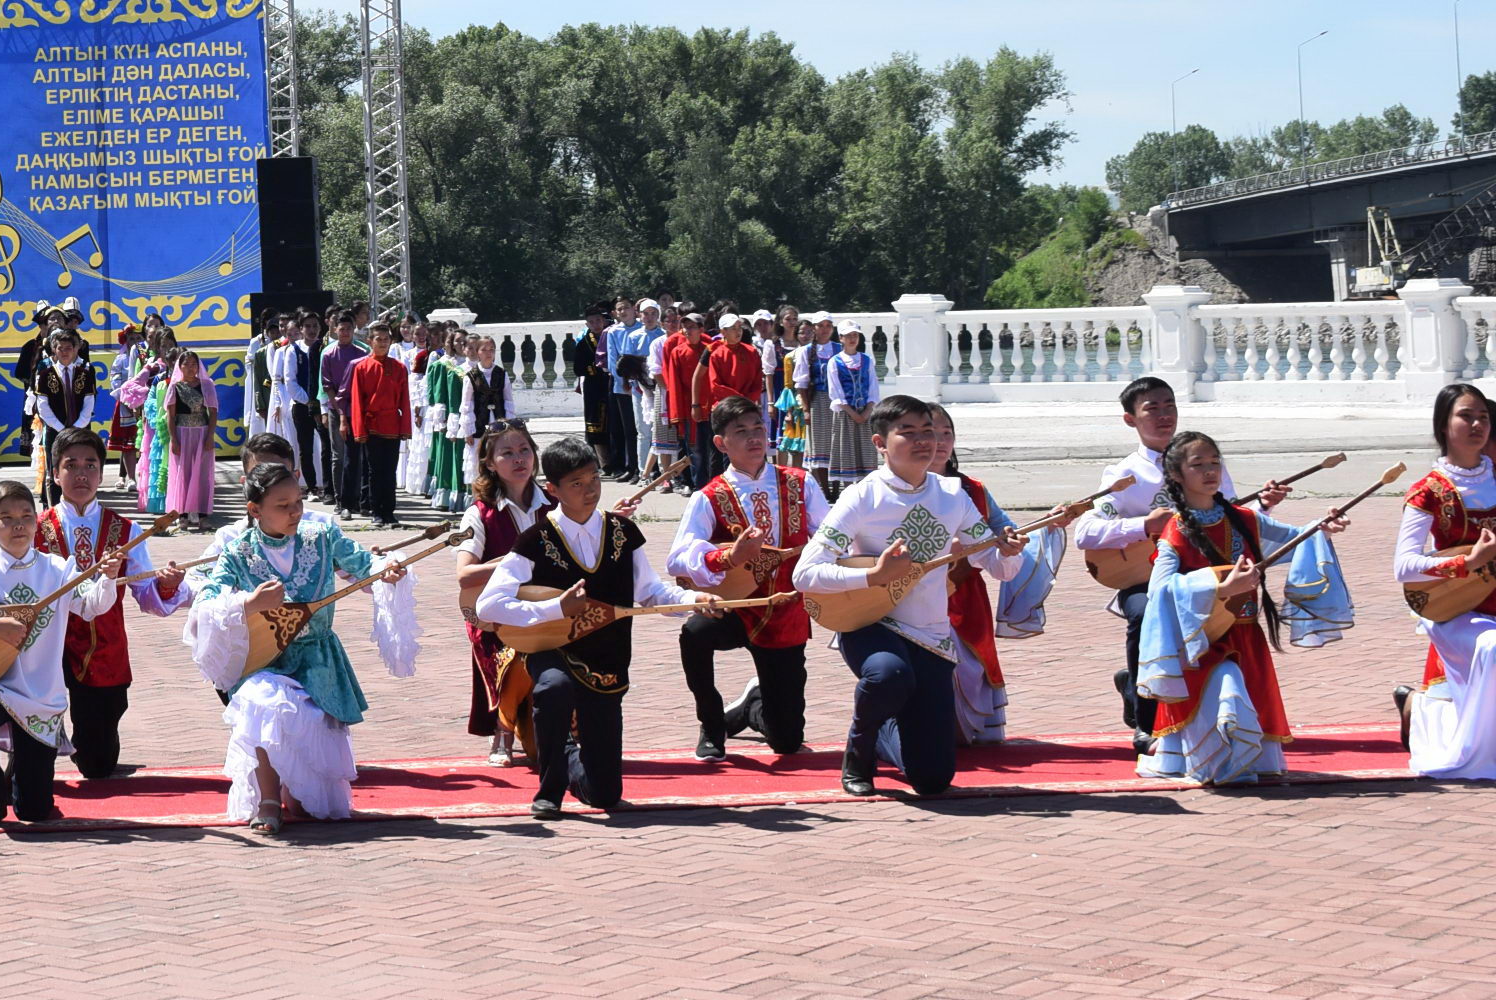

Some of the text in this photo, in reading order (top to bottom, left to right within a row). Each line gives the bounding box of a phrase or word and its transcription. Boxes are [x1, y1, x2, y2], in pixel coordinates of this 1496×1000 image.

[35, 42, 247, 62] АЛТЫН КҮН АСПАНЫ,
[33, 62, 251, 83] АЛТЫН ДӘН ДАЛАСЫ,
[46, 85, 239, 105] ЕРЛІКТІҢ ДАСТАНЫ,
[63, 106, 224, 126] ЕЛІМЕ ҚАРАШЫ!
[41, 126, 247, 148] ЕЖЕЛДЕН ЕР ДЕГЕН,
[16, 142, 266, 171] ДАҢҚЫМЫЗ ШЫҚТЫ ҒОЙ
[31, 173, 143, 190] НАМЫСЫН
[30, 186, 257, 213] ҚАЗАҒЫМ МЫҚТЫ ҒОЙ
